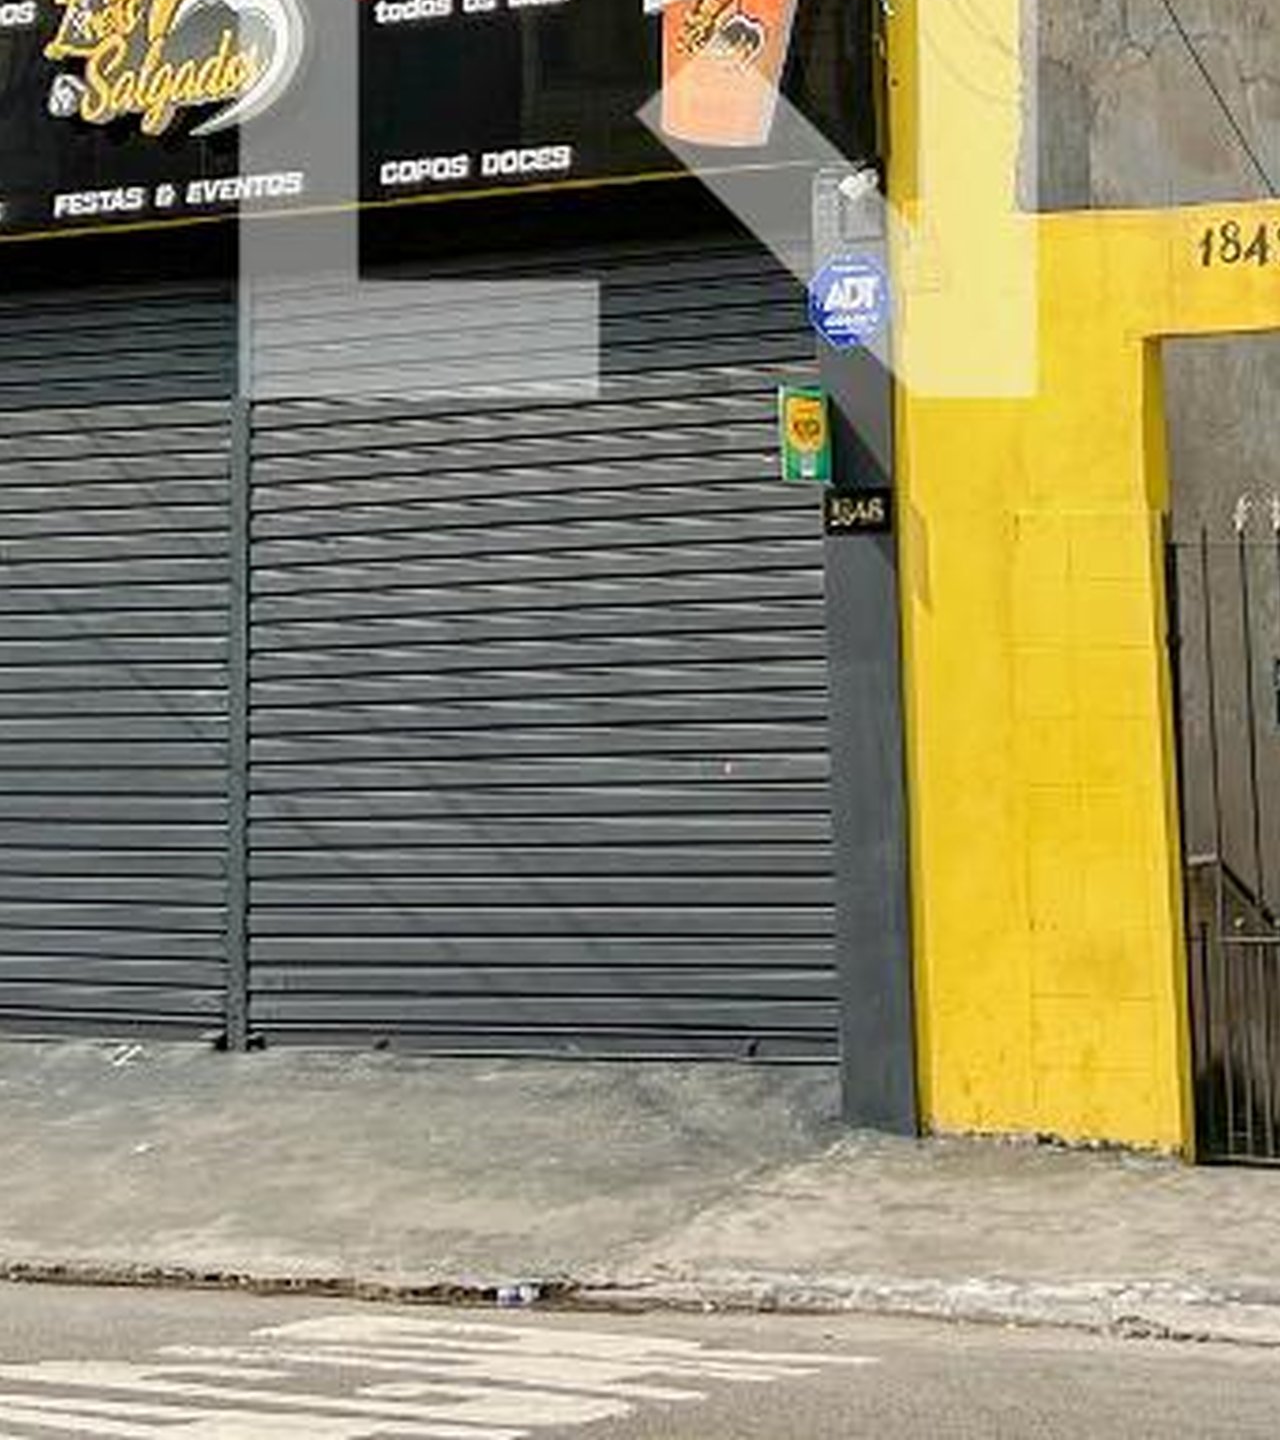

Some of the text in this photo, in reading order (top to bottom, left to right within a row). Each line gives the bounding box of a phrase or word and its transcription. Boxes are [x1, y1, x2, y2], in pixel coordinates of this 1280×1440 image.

[380, 144, 572, 185] COPOS DOCES
[54, 171, 305, 218] FESTAS & EVENTOS
[823, 276, 881, 312] ADT
